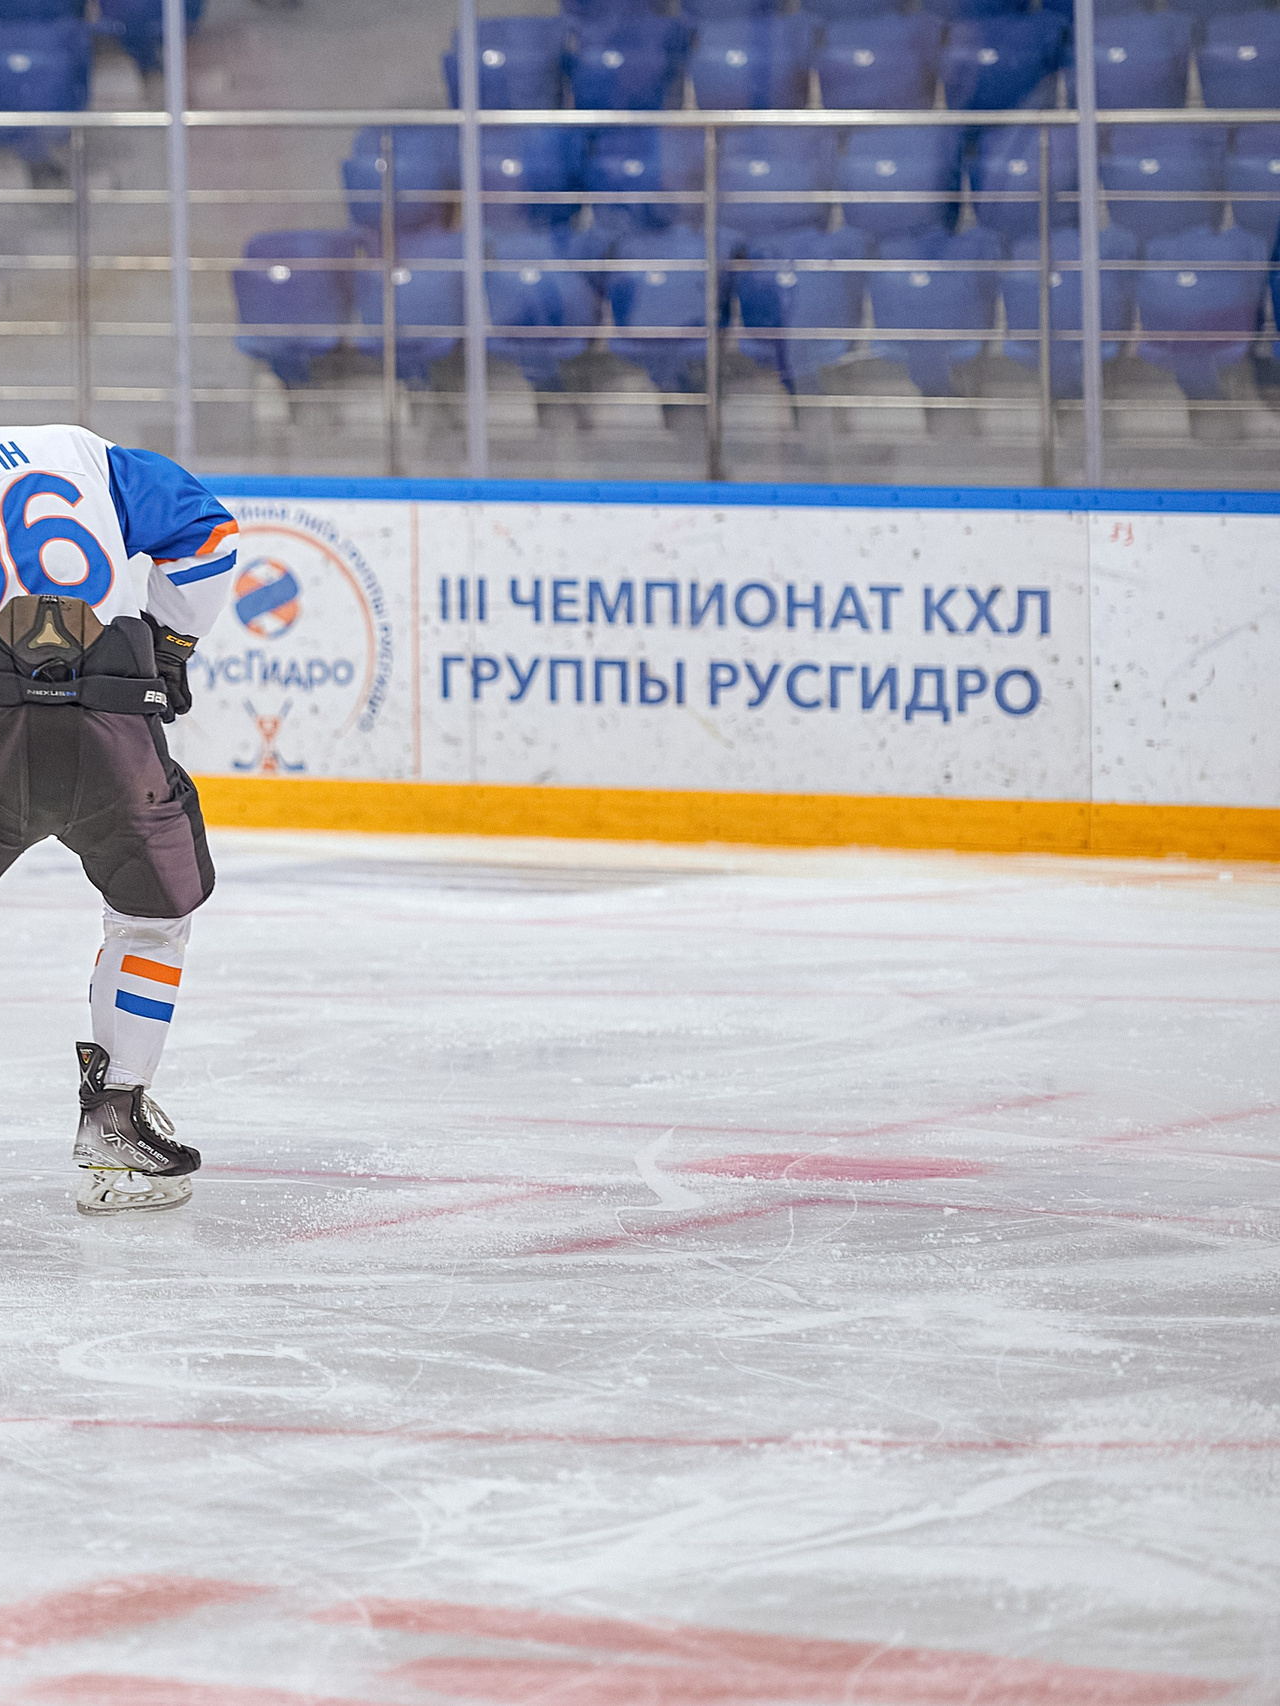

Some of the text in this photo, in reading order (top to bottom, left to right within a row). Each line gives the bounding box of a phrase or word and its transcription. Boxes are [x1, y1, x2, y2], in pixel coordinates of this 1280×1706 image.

[438, 575, 1051, 636] III ЧЕМПИОНАТ КХЛ
[438, 653, 1042, 724] ГРУППЫ РУСГИДРО
[100, 1124, 159, 1173] VAPOR
[136, 1139, 171, 1166] BAUER
